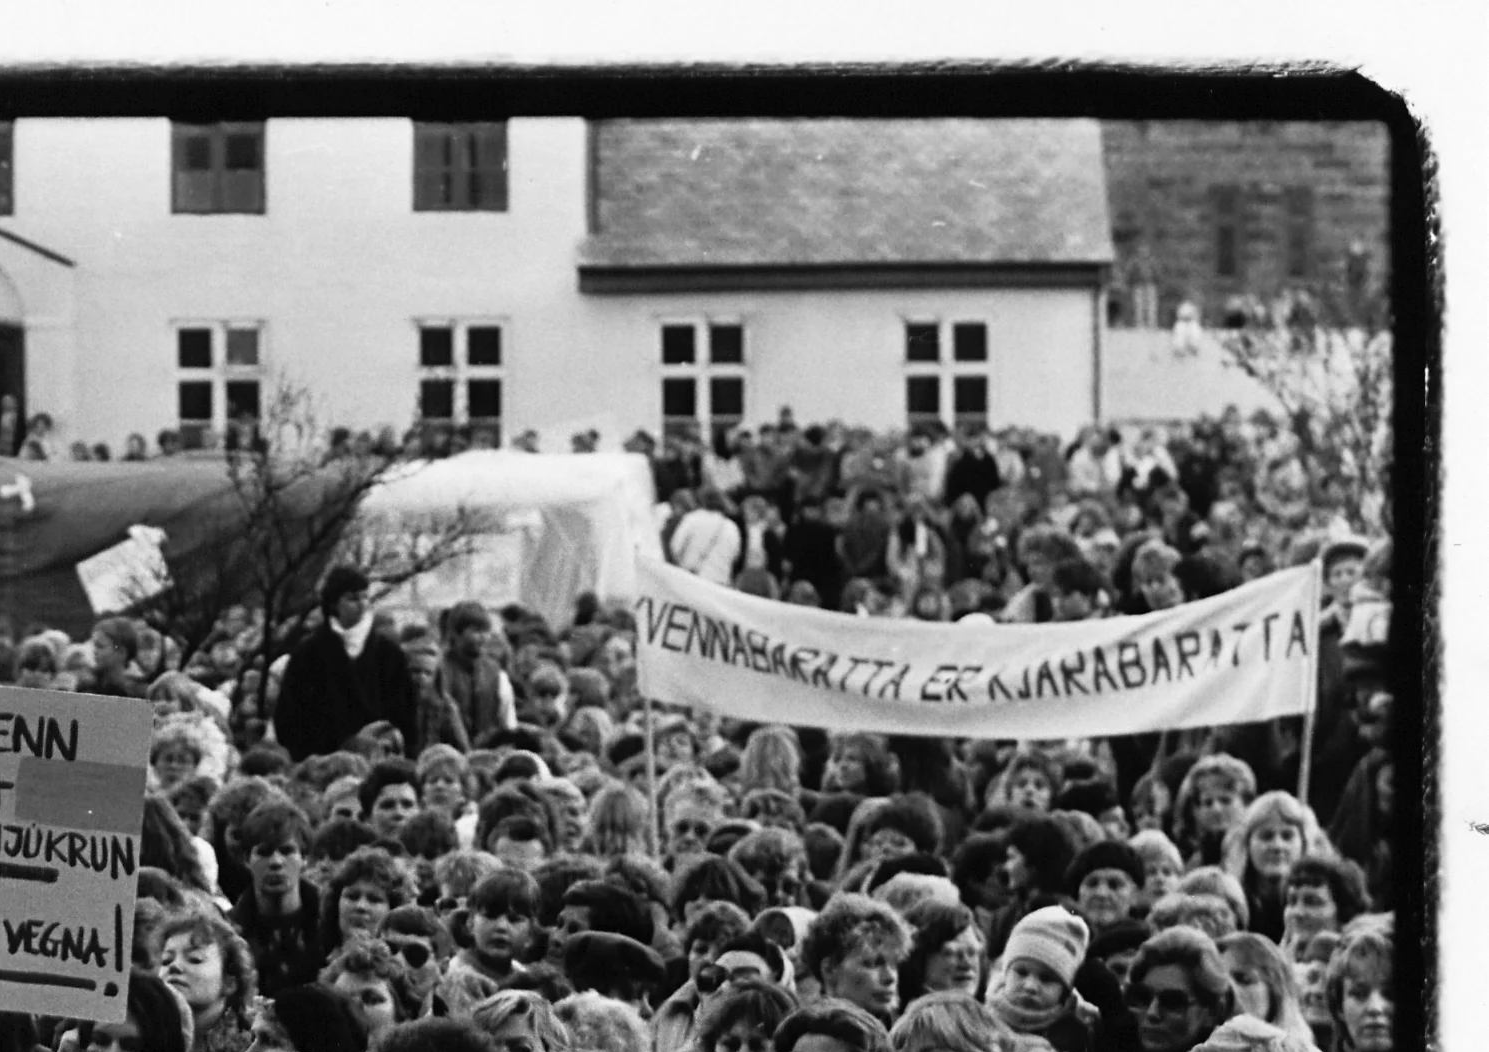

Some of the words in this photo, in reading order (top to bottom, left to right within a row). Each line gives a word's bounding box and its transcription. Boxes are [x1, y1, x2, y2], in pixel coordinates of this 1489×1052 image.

[635, 596, 911, 700] VENNABARATTA
[919, 664, 984, 702] ER
[2, 902, 125, 997] VEGNA!
